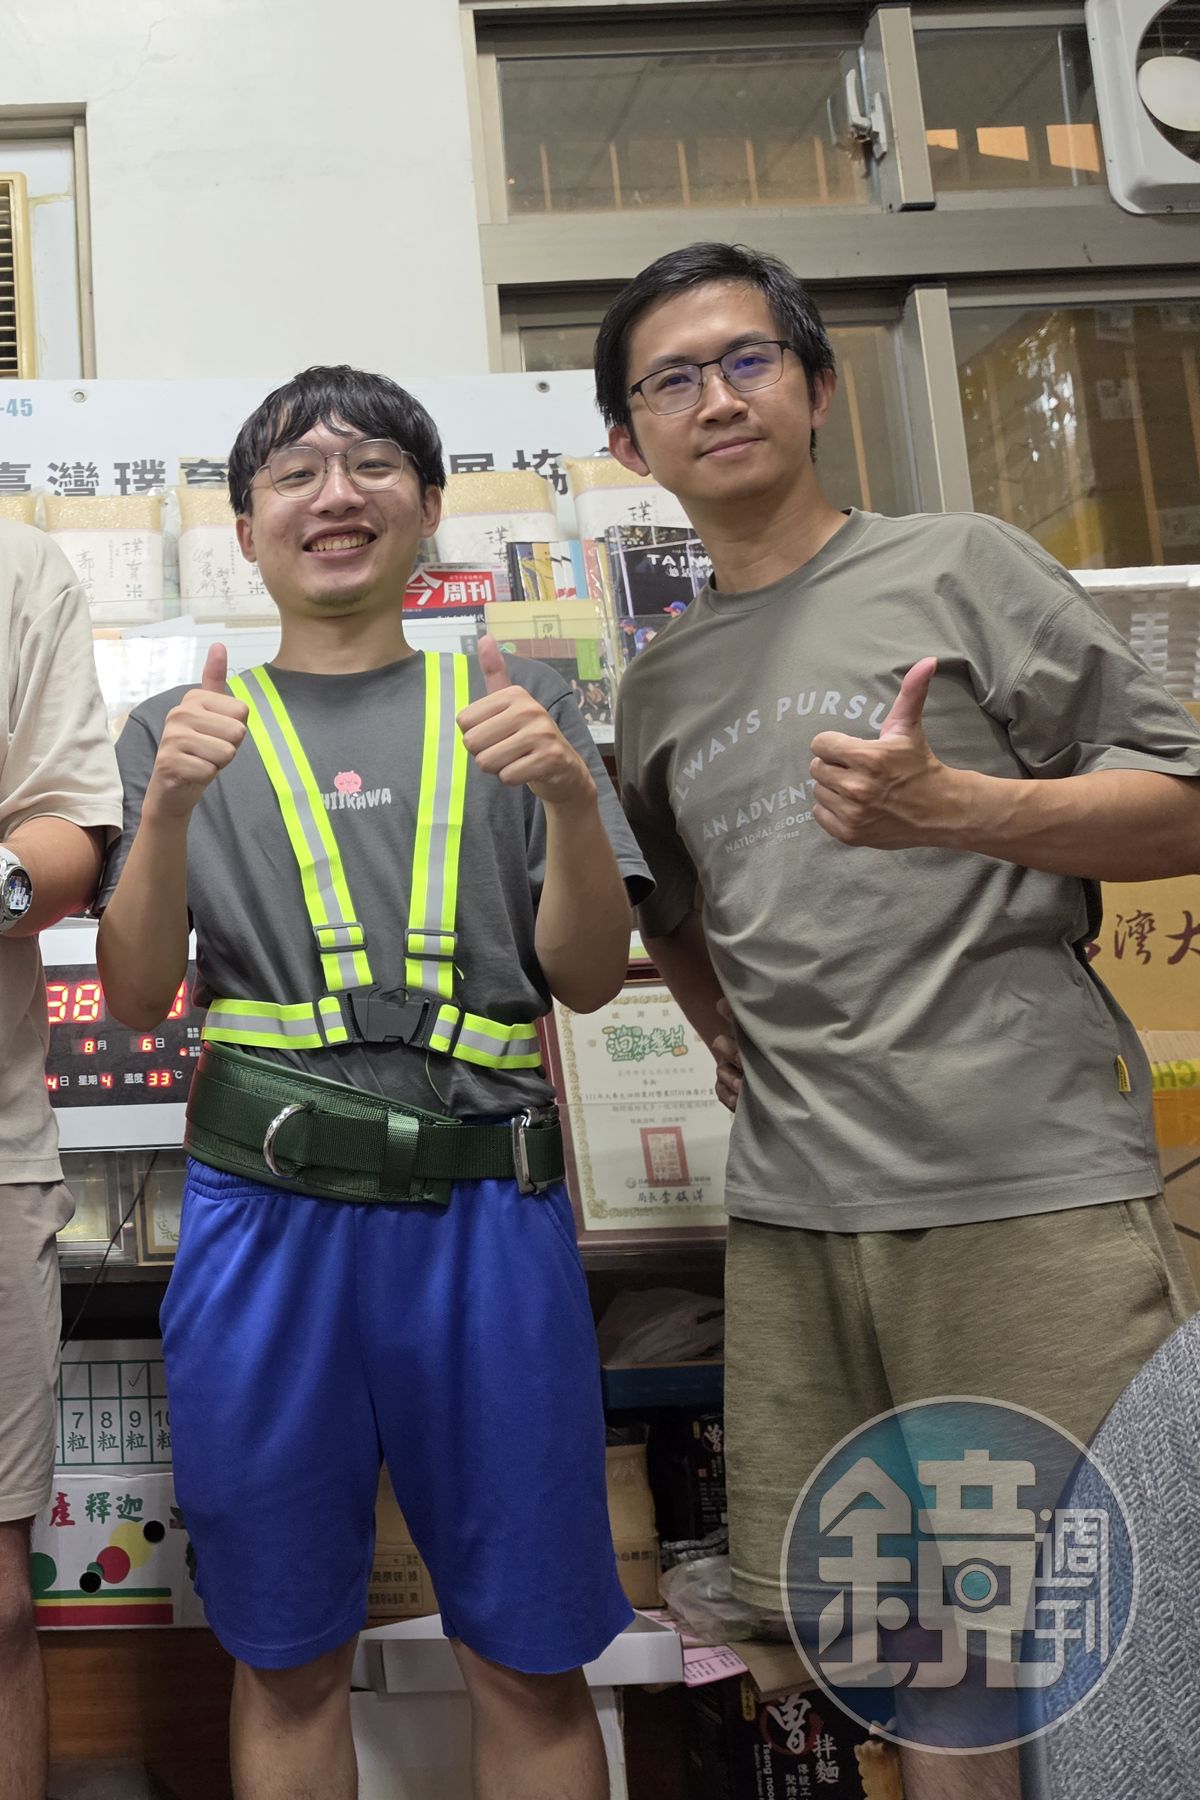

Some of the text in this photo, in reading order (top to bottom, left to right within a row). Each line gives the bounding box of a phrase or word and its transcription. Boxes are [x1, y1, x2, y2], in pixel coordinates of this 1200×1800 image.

[406, 565, 493, 606] 今周刊
[674, 709, 761, 815] LWAYS
[775, 811, 815, 832] GEOGR
[72, 1411, 84, 1429] 7
[101, 1411, 113, 1429] 8
[129, 1410, 141, 1428] 9
[67, 1432, 89, 1452] 粒
[98, 1431, 119, 1452] 粒
[126, 1430, 148, 1451] 粒
[812, 1733, 840, 1784] 拌麵
